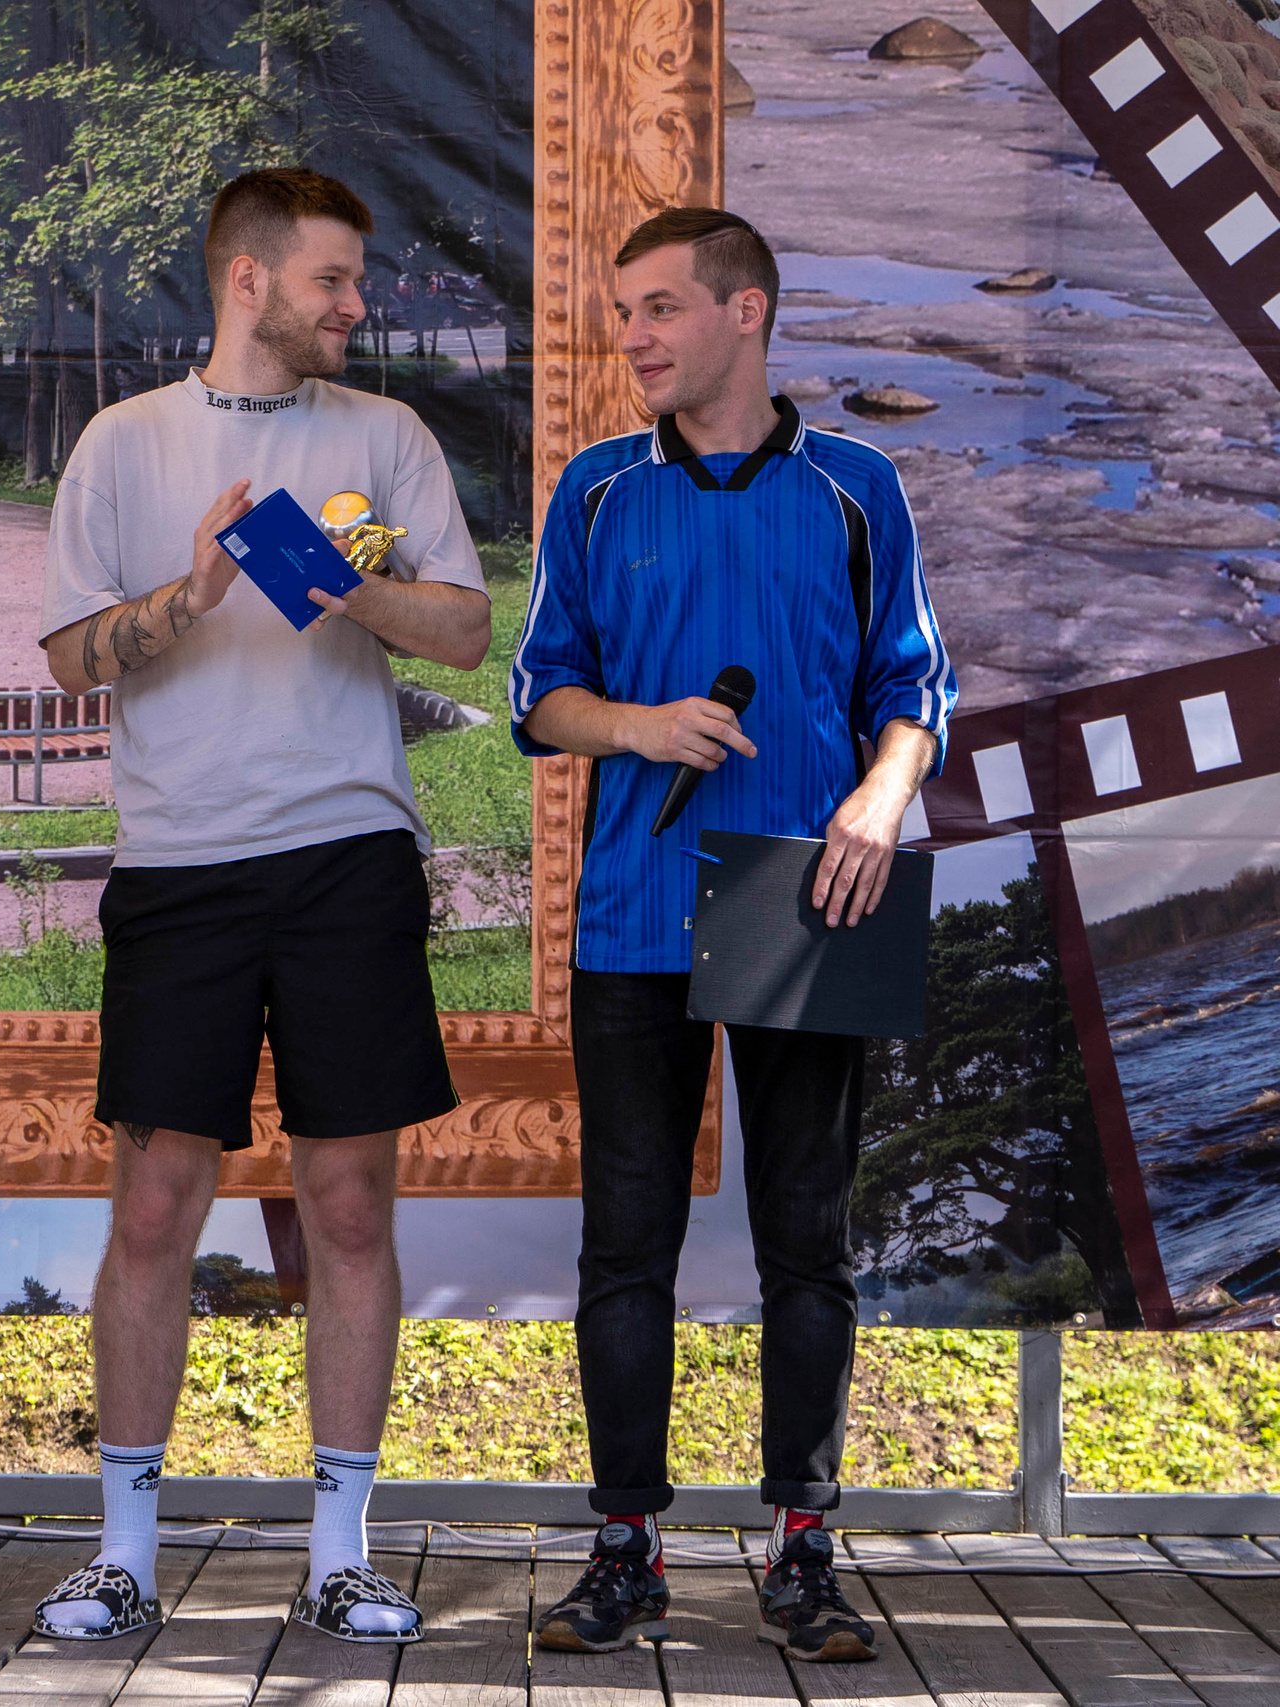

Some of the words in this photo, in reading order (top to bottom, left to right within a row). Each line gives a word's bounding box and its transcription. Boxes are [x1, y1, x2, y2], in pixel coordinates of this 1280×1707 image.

[206, 391, 233, 410] Los
[237, 393, 298, 414] Angeles
[131, 1479, 161, 1491] Kap
